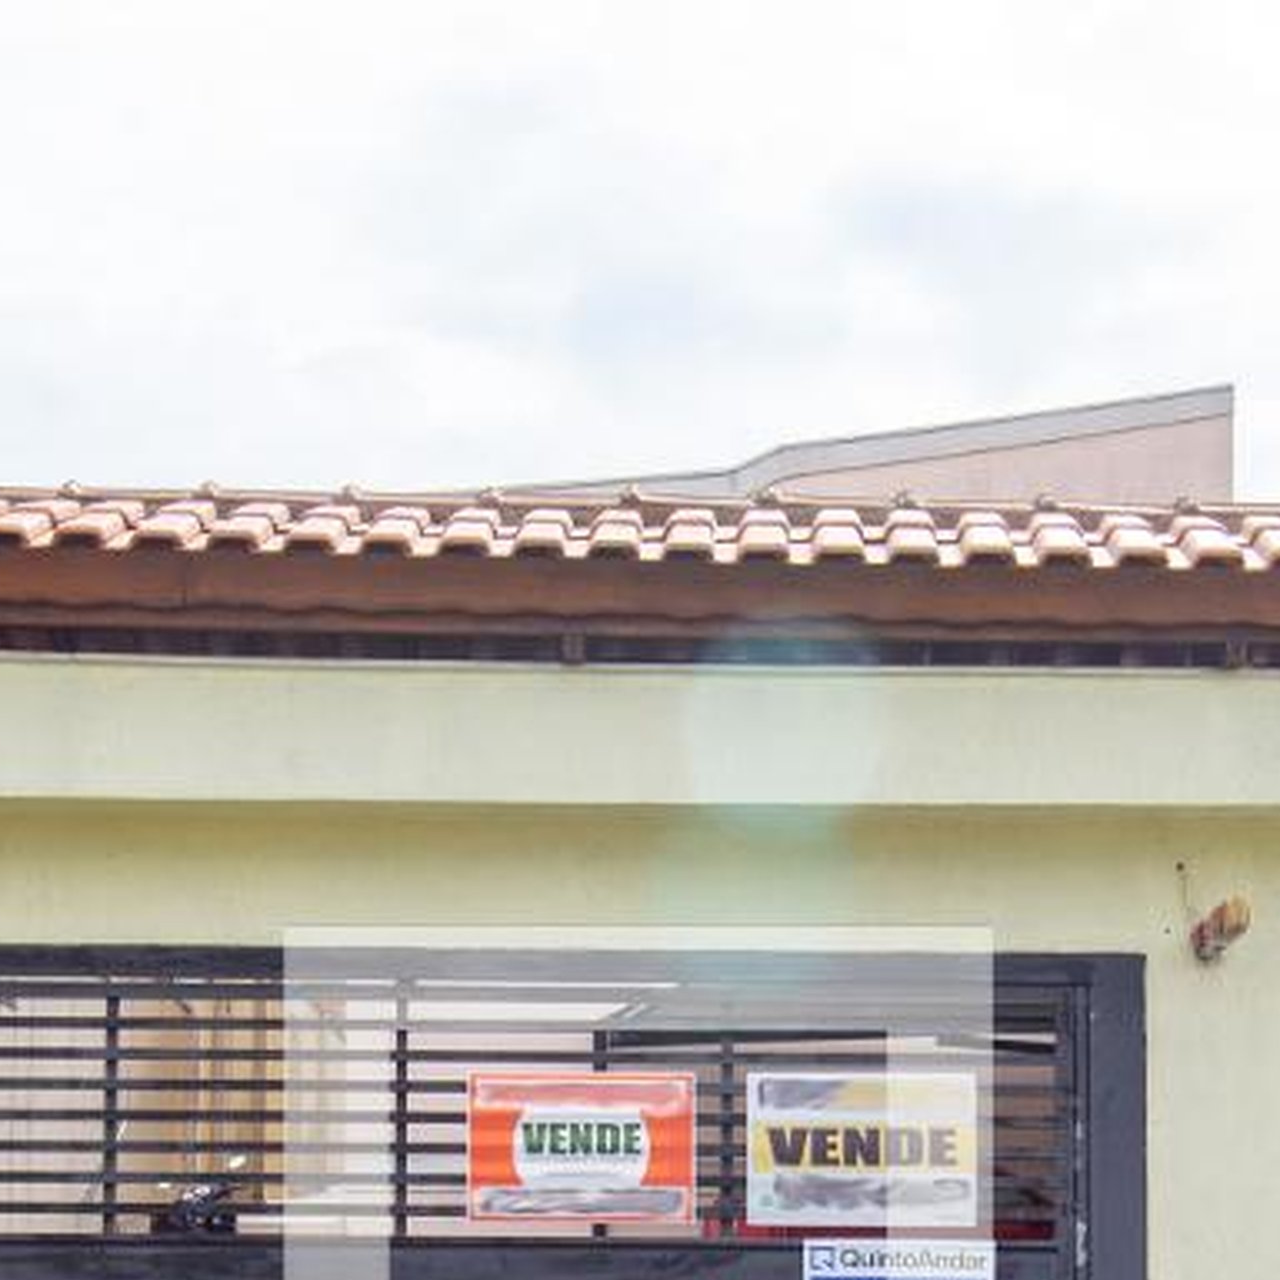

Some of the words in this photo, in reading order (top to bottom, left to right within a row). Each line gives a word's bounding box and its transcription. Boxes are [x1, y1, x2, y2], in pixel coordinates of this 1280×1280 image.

[521, 1122, 641, 1155] VENDE
[766, 1126, 958, 1167] VENDE
[840, 1248, 987, 1269] QuintoAndar
